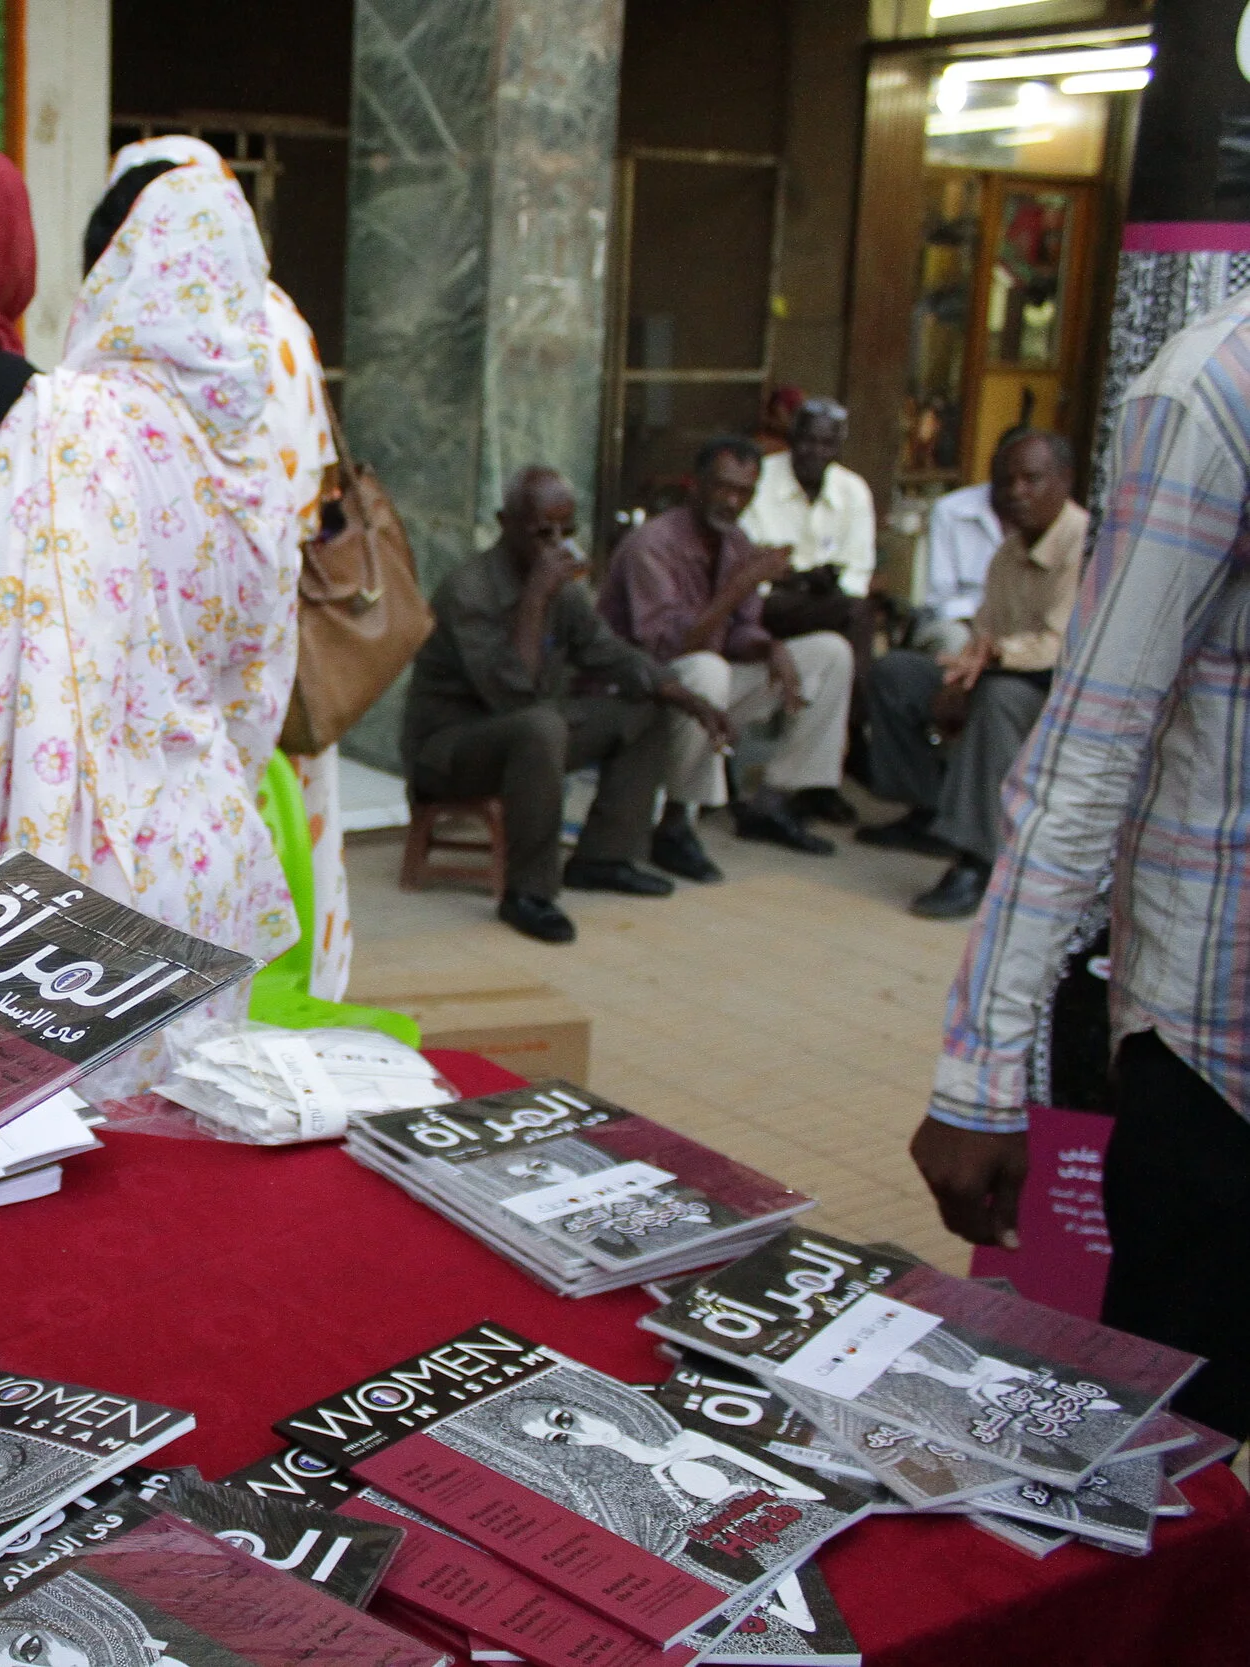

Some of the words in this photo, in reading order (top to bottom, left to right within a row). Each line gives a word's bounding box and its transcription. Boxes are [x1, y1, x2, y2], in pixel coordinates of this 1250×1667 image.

[43, 1022, 88, 1046] في
[407, 1090, 591, 1147] المرأة
[688, 1240, 862, 1339] المرأة
[290, 1324, 526, 1442] WOMEN
[398, 1402, 436, 1430] IN
[448, 1344, 551, 1402] ISLAM
[16, 1412, 134, 1452] ISLAM
[86, 1513, 123, 1542] في
[709, 1505, 801, 1559] Hijab
